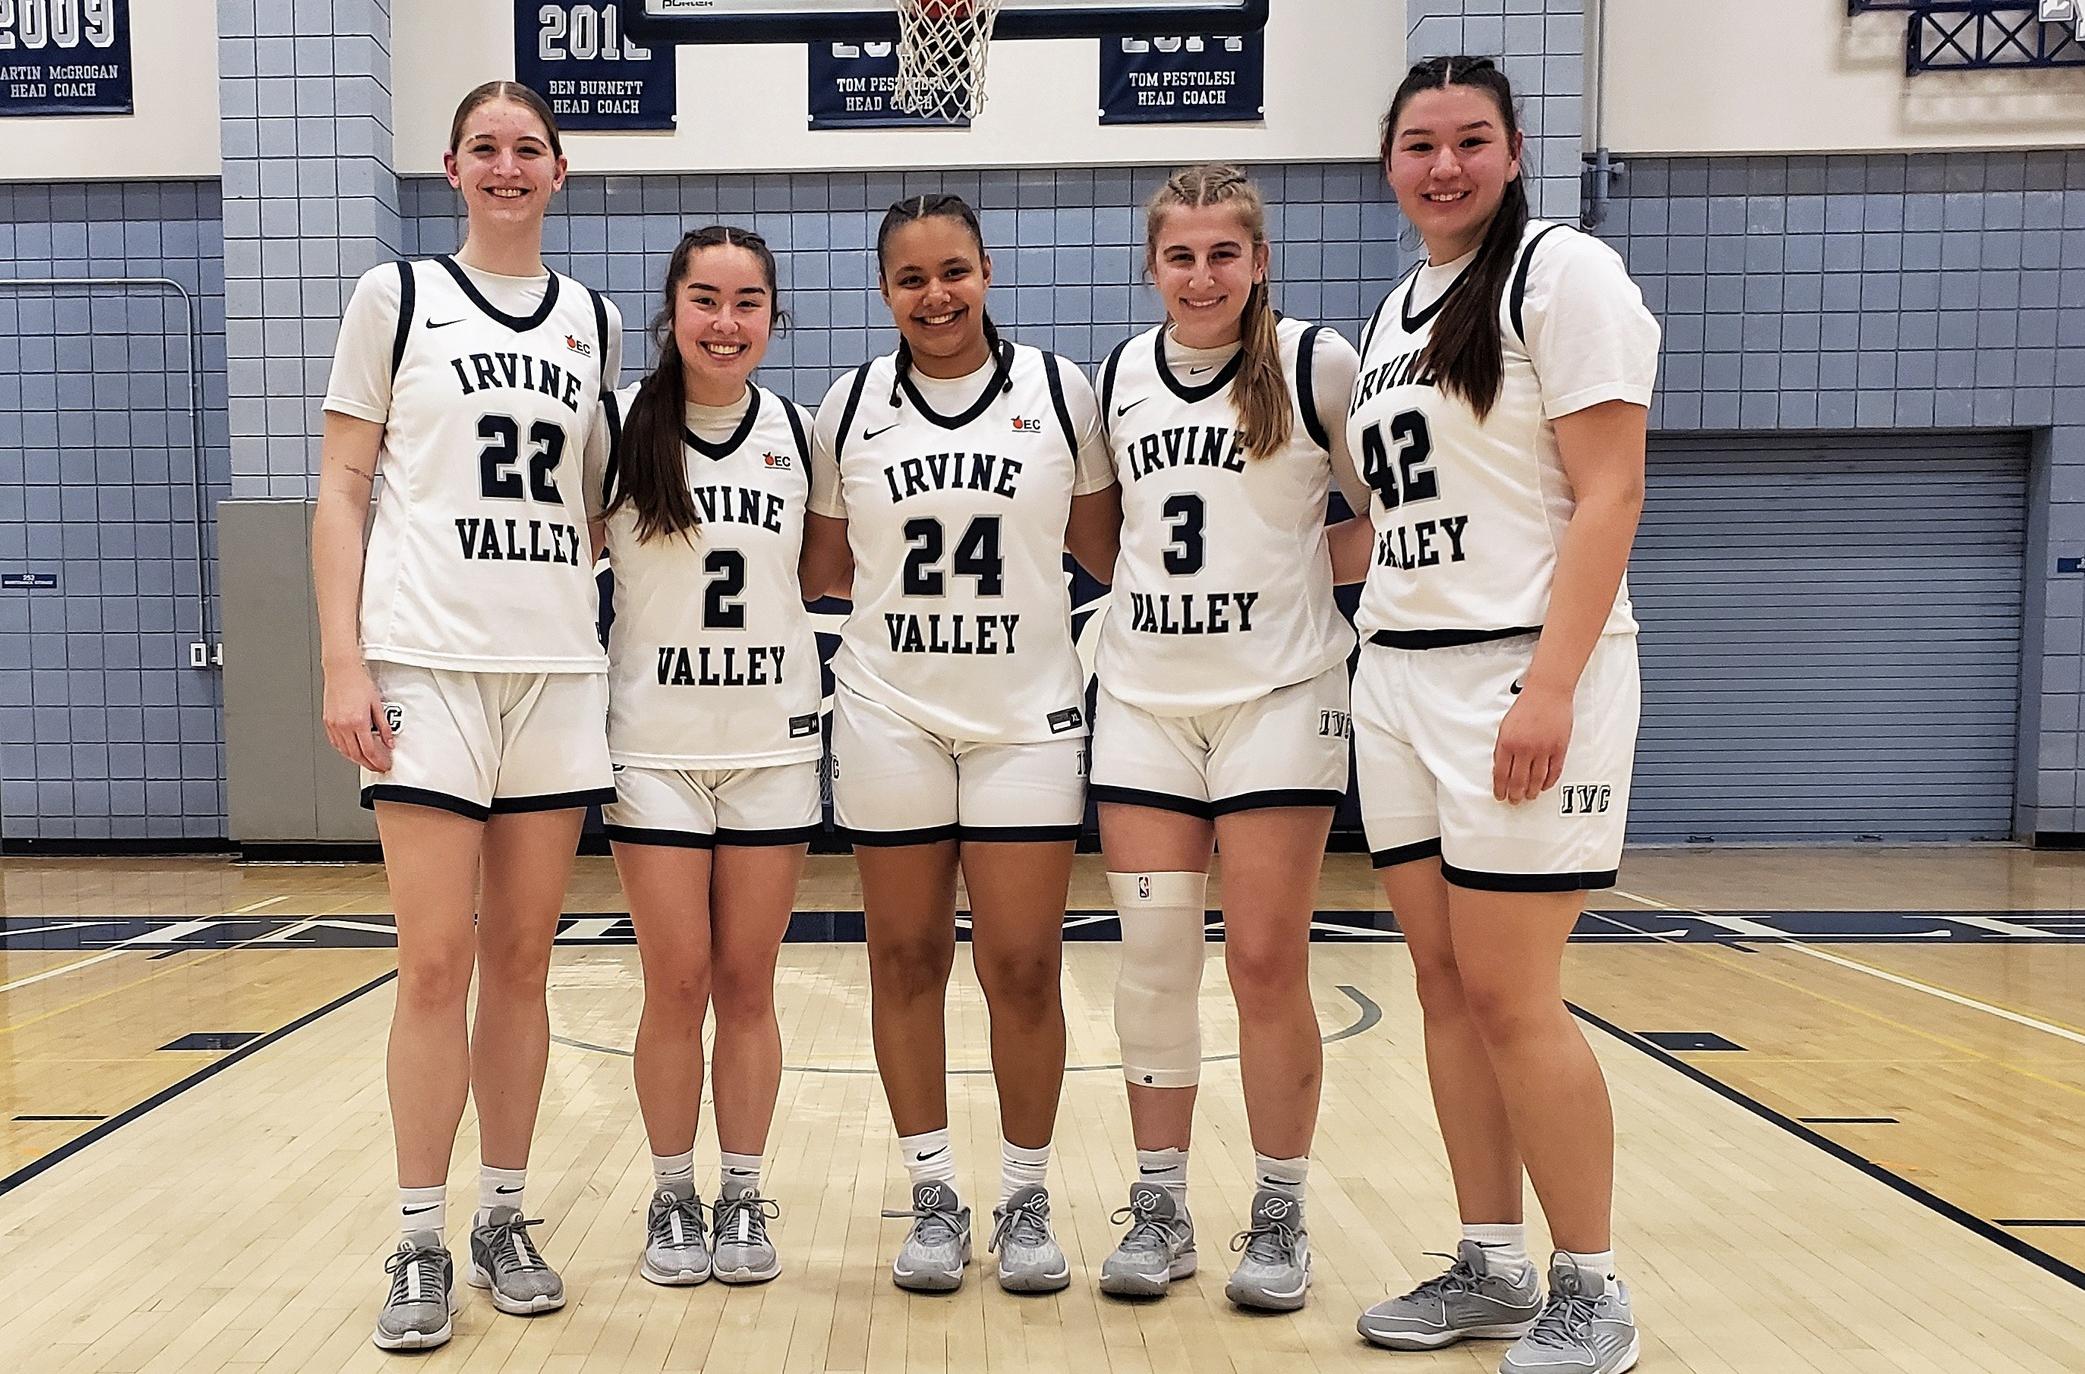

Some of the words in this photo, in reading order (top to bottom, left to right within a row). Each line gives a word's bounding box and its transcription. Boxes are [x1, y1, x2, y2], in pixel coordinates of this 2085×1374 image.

[10, 84, 46, 98] HEAD
[54, 83, 96, 97] COACH
[49, 65, 118, 79] McGROGAN
[549, 81, 575, 95] BEN
[580, 81, 643, 95] BURNETT
[837, 78, 866, 92] TOM
[1129, 72, 1159, 87] TOM
[1163, 71, 1236, 86] PESTOLESI
[553, 100, 589, 114] HEAD
[597, 100, 640, 114] COACH
[846, 97, 882, 111] HEAD
[1138, 91, 1175, 105] HEAD
[1183, 90, 1226, 104] COACH
[450, 352, 582, 413] IRVINE
[475, 412, 568, 507] 22
[884, 453, 1023, 504] IRVINE
[1362, 406, 1440, 514] 42
[455, 518, 580, 567] VALLEY
[1161, 491, 1207, 577] 3
[902, 514, 1005, 598] 24
[702, 548, 747, 631] 2
[885, 613, 1020, 655] VALLEY
[1130, 592, 1259, 635] VALLEY
[657, 646, 785, 686] VALLEY
[1561, 784, 1611, 814] IVC
